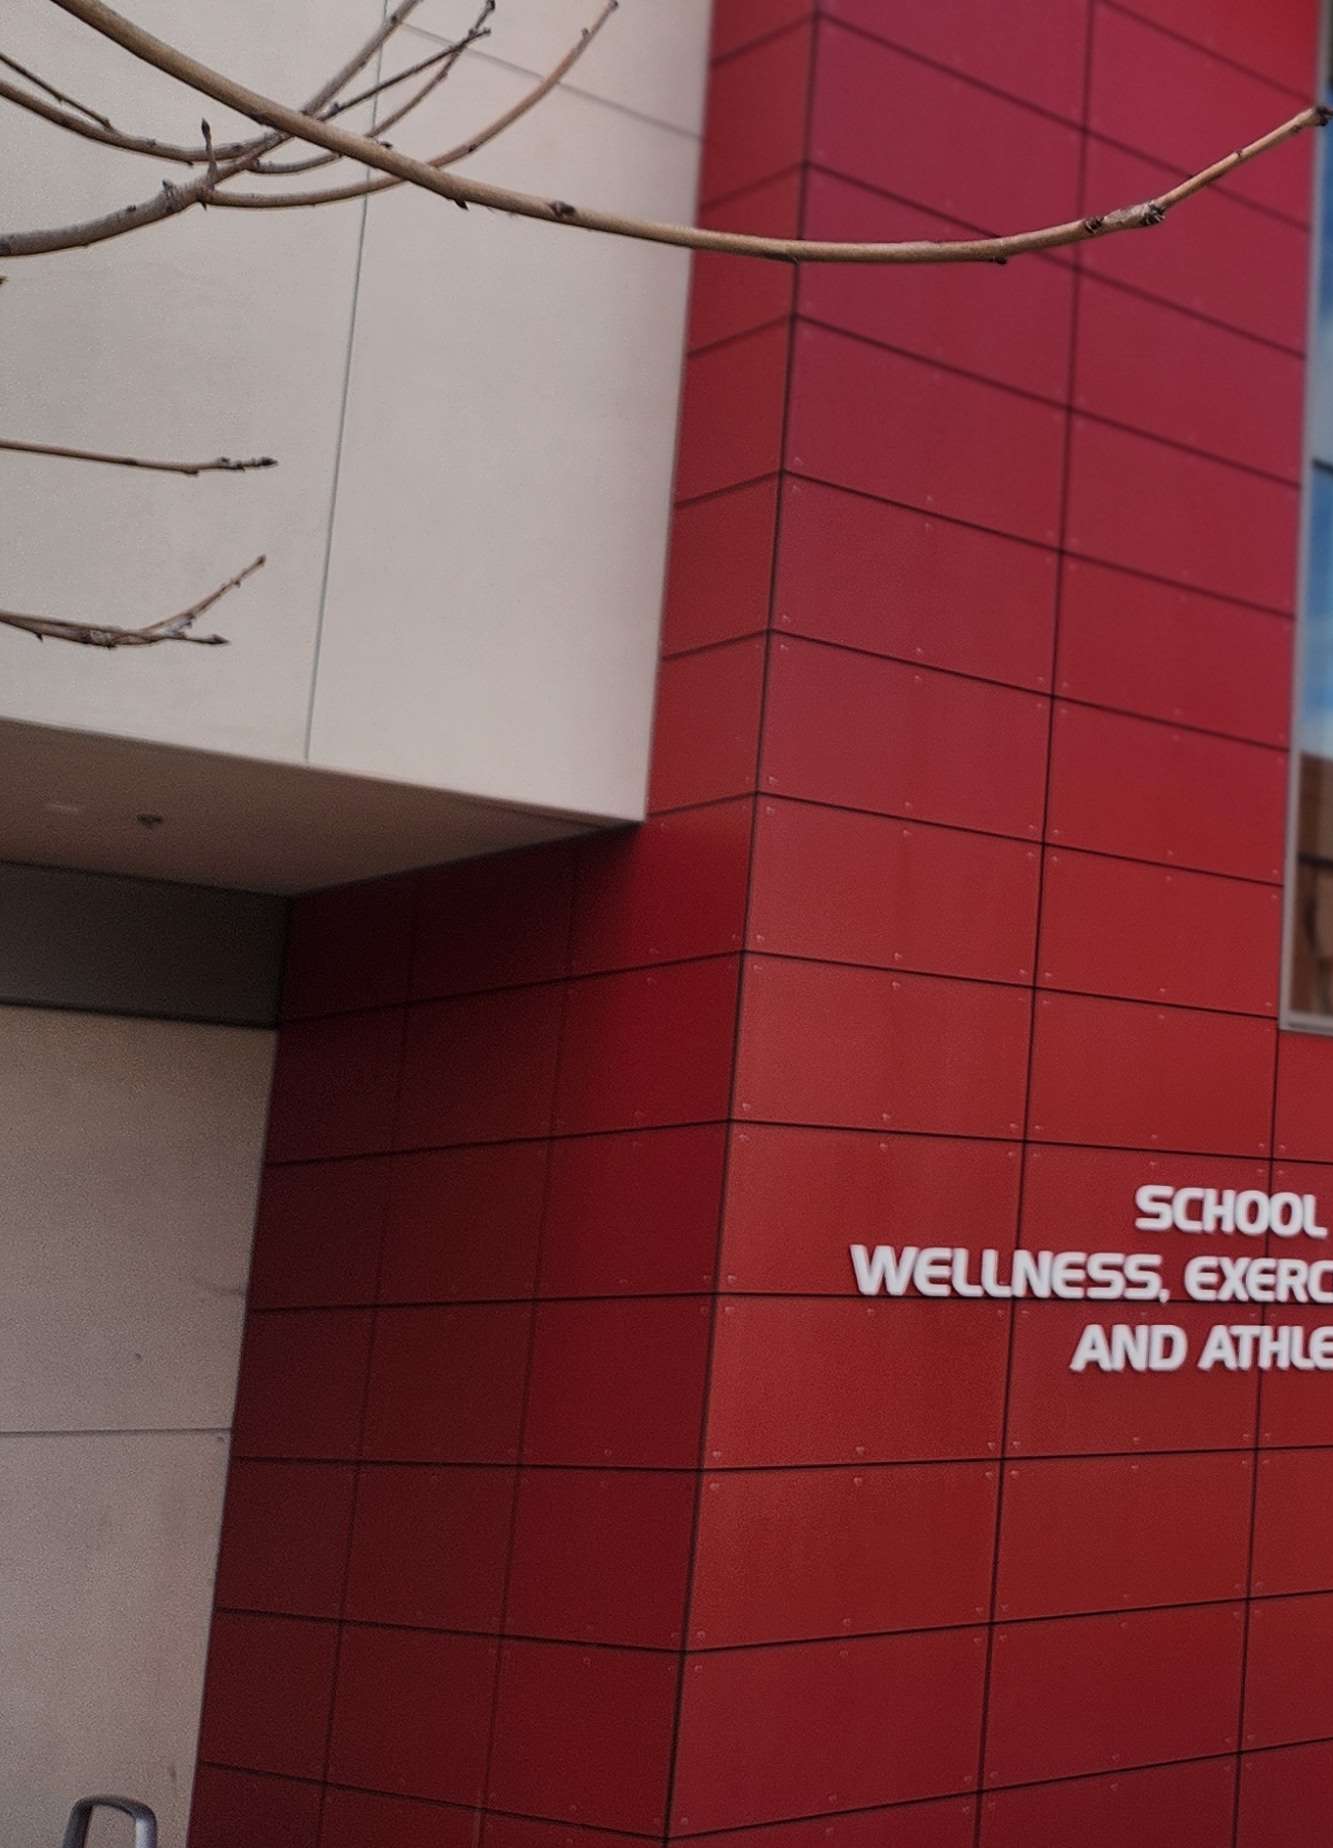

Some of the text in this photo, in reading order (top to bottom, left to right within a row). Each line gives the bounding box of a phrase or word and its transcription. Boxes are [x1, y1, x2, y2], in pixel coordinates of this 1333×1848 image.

[1134, 1183, 1329, 1239] SCHOOL
[849, 1243, 1171, 1304] WELLNESS,
[1068, 1323, 1189, 1373] AND
